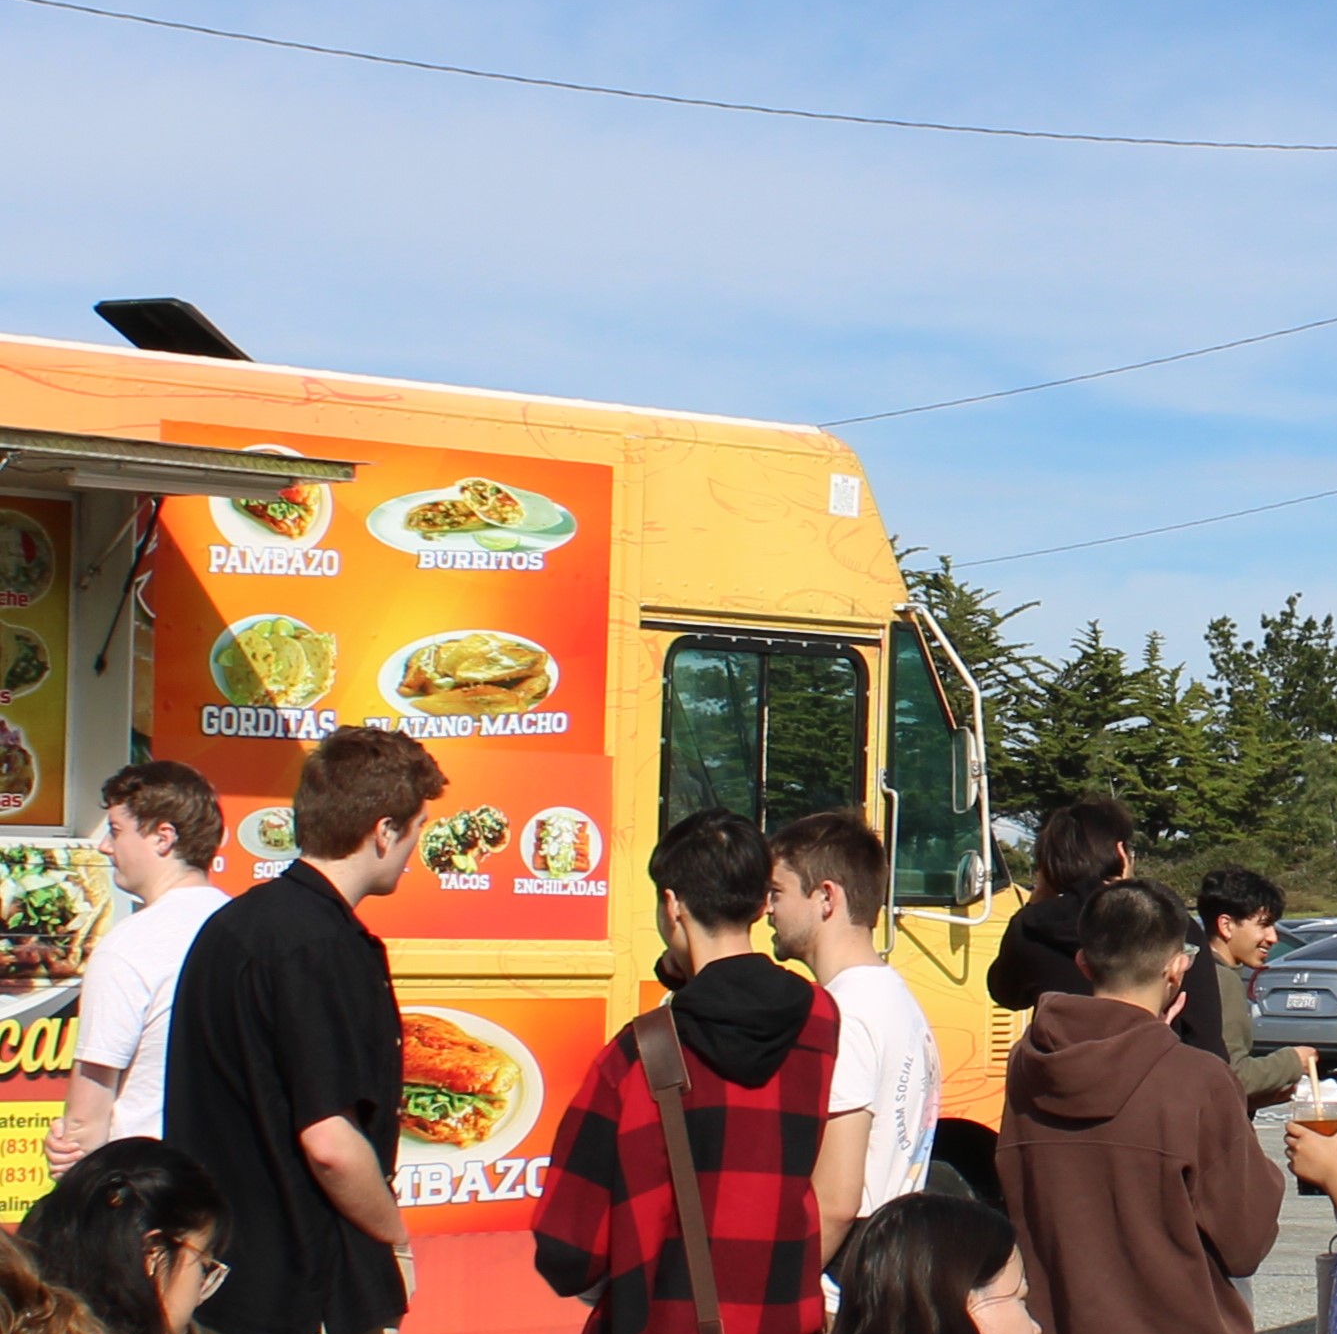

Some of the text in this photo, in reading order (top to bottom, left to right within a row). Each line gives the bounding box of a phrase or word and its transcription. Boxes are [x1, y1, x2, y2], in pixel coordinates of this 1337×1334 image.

[208, 545, 341, 576] PAMBAZO
[417, 550, 545, 570] BURRITOS
[201, 705, 337, 740] GORDITAS
[439, 873, 490, 890] TACOS
[513, 878, 607, 896] ENCHILADAS
[895, 1055, 914, 1104] SOCIAL
[1, 1137, 46, 1158] (831)
[0, 1166, 44, 1185] (831)
